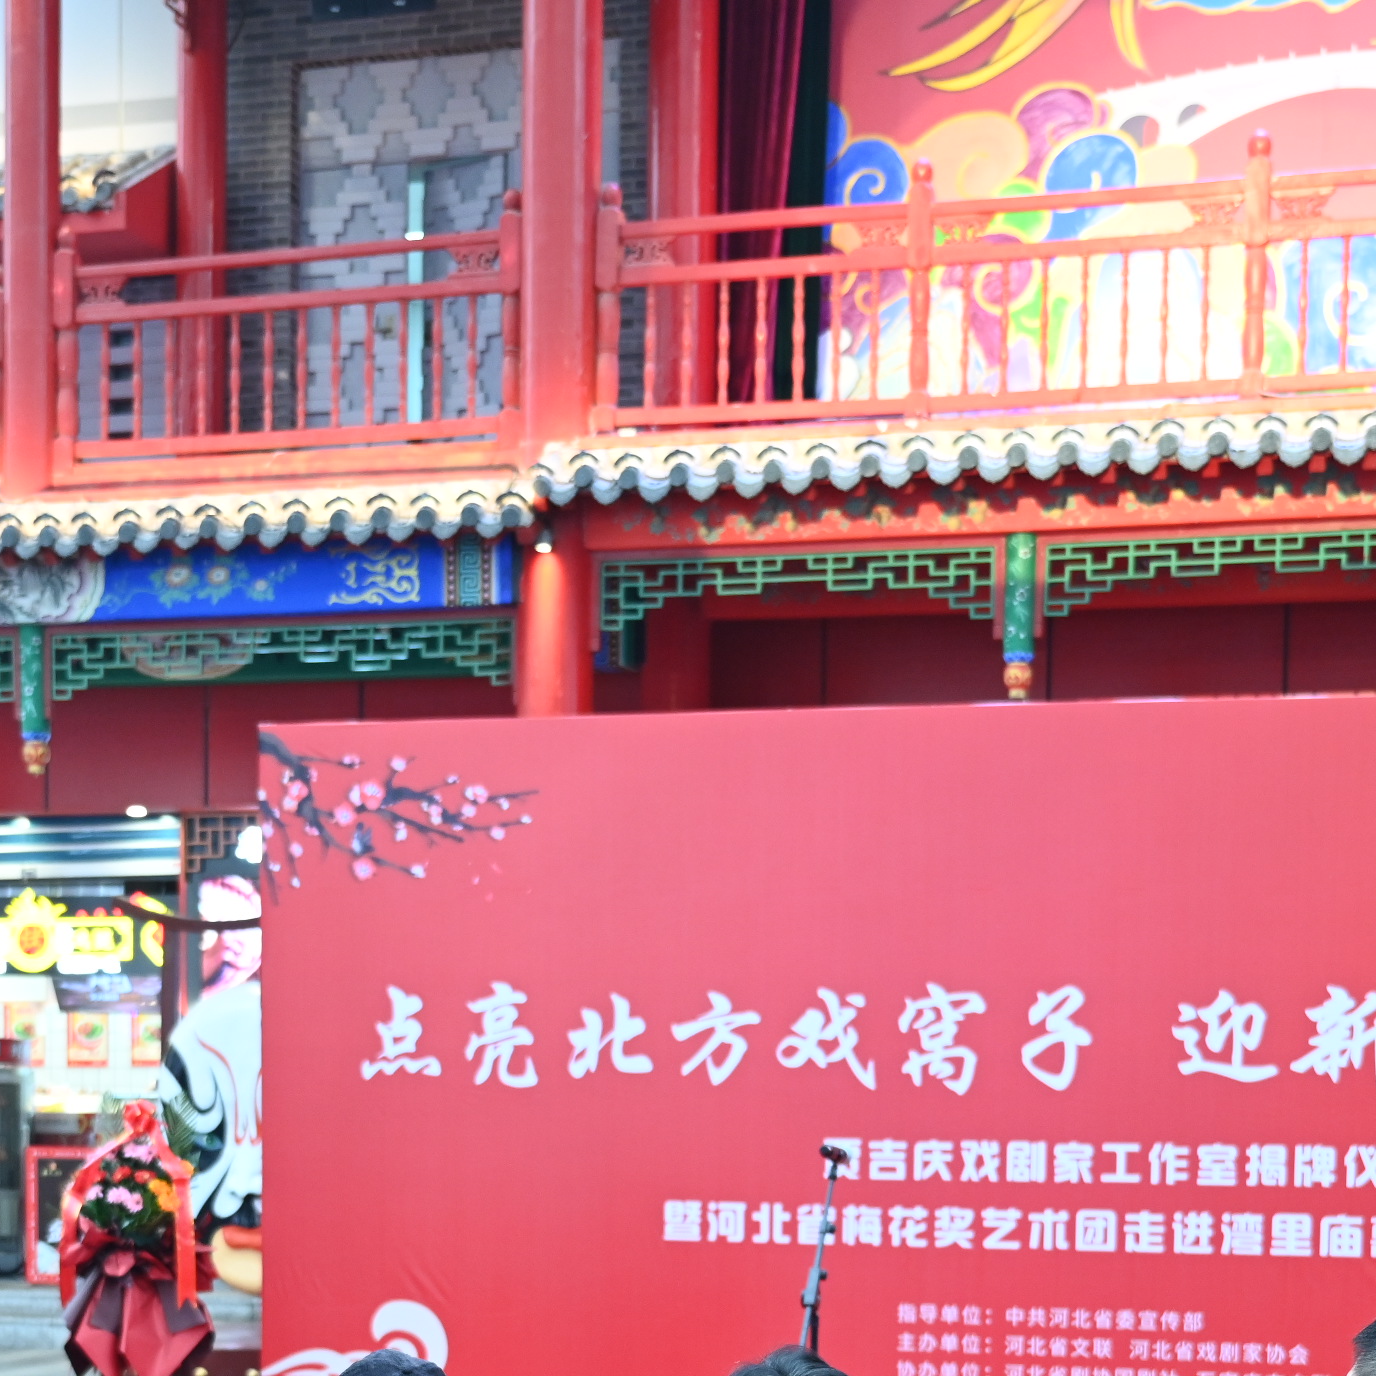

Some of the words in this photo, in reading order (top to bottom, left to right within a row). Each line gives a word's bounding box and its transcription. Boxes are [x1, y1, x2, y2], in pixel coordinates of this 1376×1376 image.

[361, 981, 1094, 1097] 点亮北方戏窝子
[897, 1303, 993, 1327] 指导单位：
[1004, 1306, 1205, 1333] 中共河北省委宣传部
[897, 1332, 993, 1356] 主办单位：
[1004, 1335, 1114, 1360] 河北省文联
[1129, 1338, 1311, 1367] 河北省戏剧家协会
